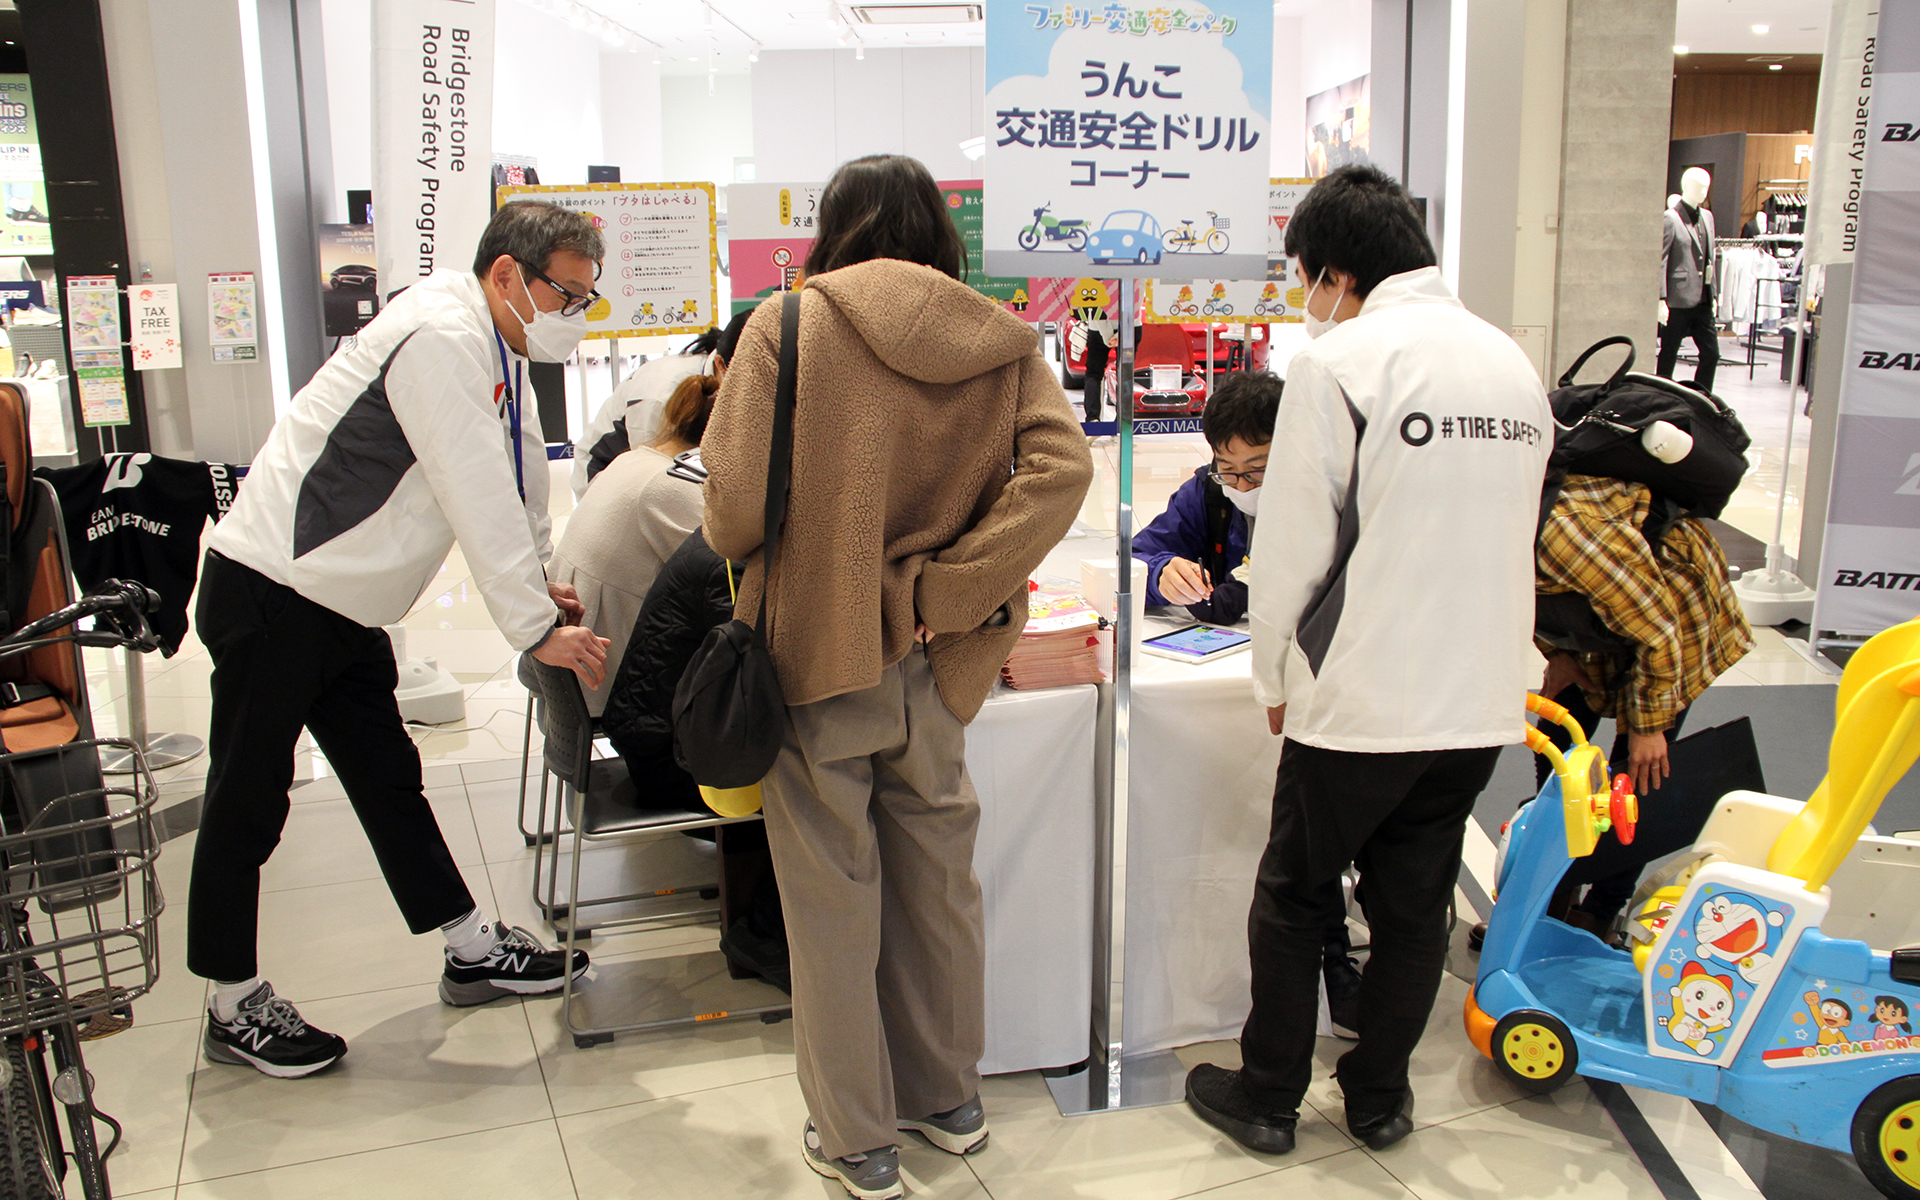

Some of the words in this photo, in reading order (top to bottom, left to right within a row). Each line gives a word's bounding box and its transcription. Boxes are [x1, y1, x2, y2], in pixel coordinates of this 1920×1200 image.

[1026, 3, 1237, 35] ファミリー交通安全パーク
[422, 24, 442, 85] Road
[1081, 59, 1182, 99] うんこ
[445, 27, 471, 172] Bridgestone
[417, 93, 442, 170] Safety
[996, 107, 1260, 152] 交通安全ドリル
[1071, 160, 1190, 189] コーナー
[416, 178, 440, 277] Program
[1842, 168, 1863, 252] Program
[351, 245, 373, 254] No.1
[141, 317, 170, 328] FREE
[143, 306, 166, 316] TAX
[1502, 418, 1542, 451] SAFETY
[1817, 1038, 1909, 1057] DORAEMON
